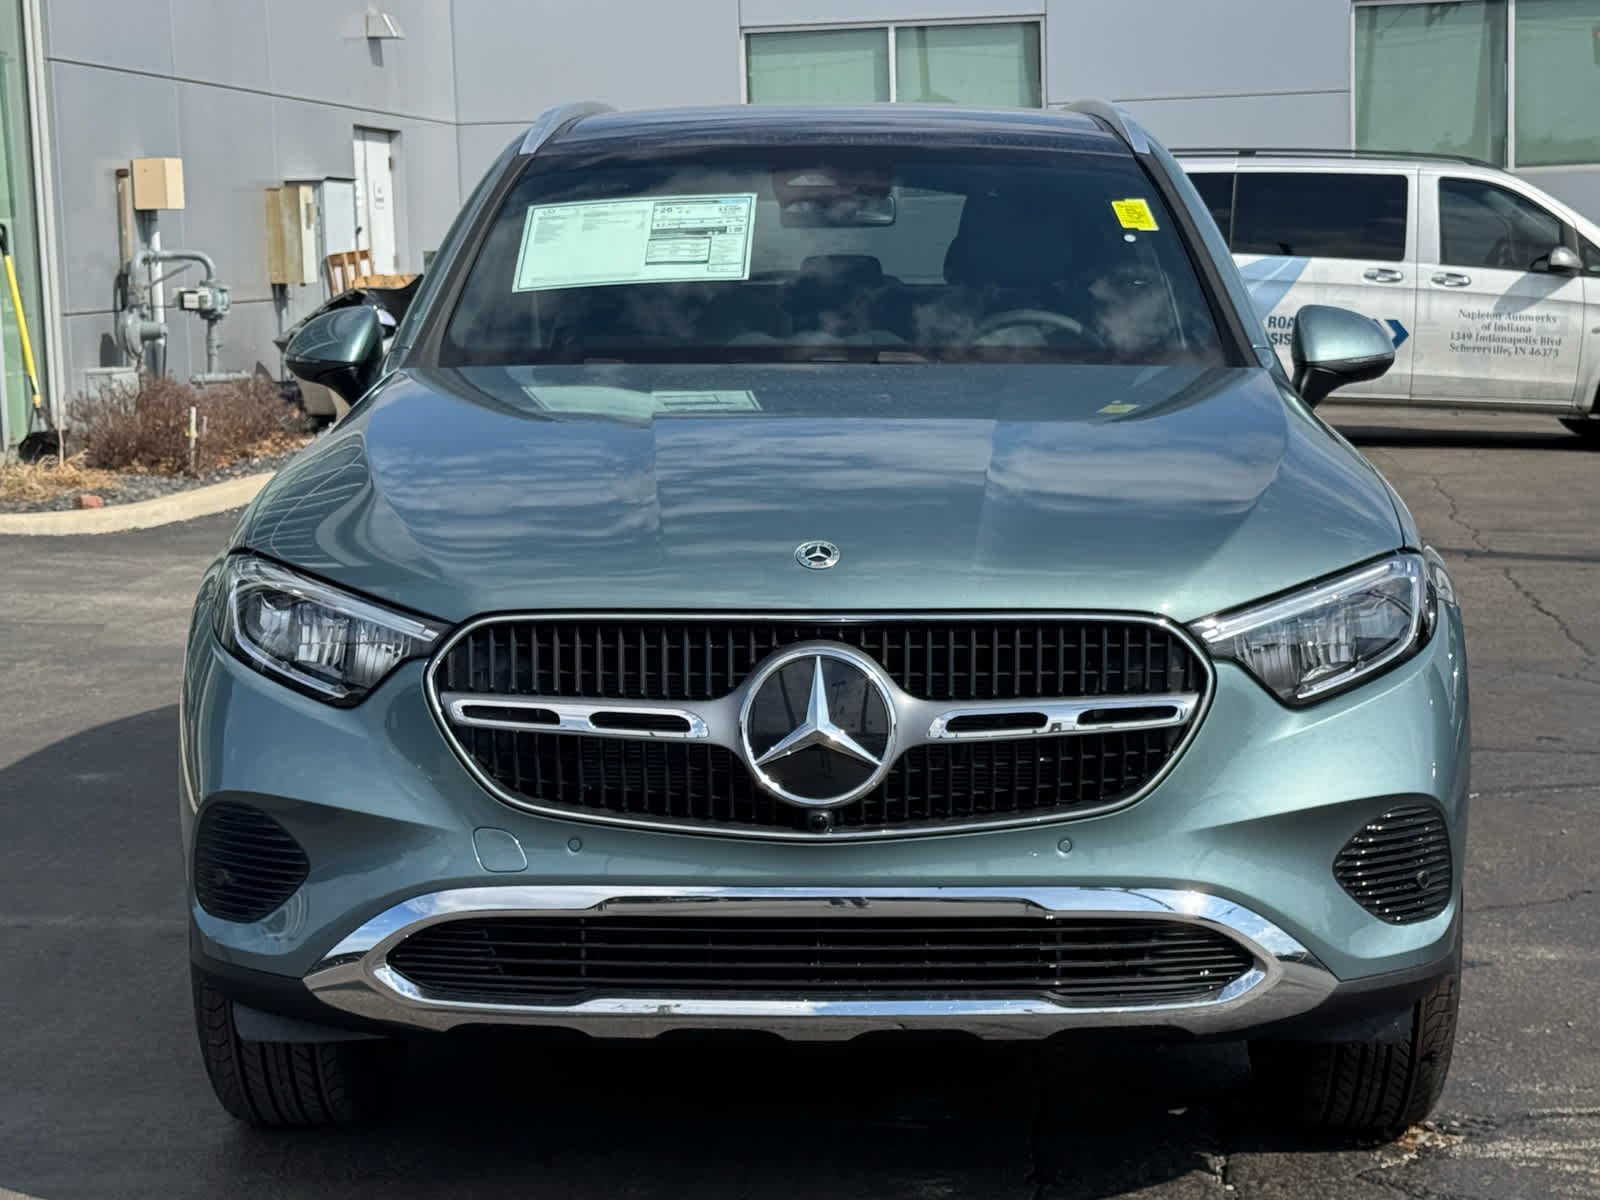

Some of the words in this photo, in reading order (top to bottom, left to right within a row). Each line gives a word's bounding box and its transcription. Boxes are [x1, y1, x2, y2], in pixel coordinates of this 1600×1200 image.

[1458, 308, 1502, 321] Napleton
[1481, 321, 1491, 331] of
[1494, 322, 1532, 333] Indiana
[1475, 333, 1538, 346] Indianapolis
[1540, 336, 1562, 347] Blvd
[1514, 346, 1526, 356] IN
